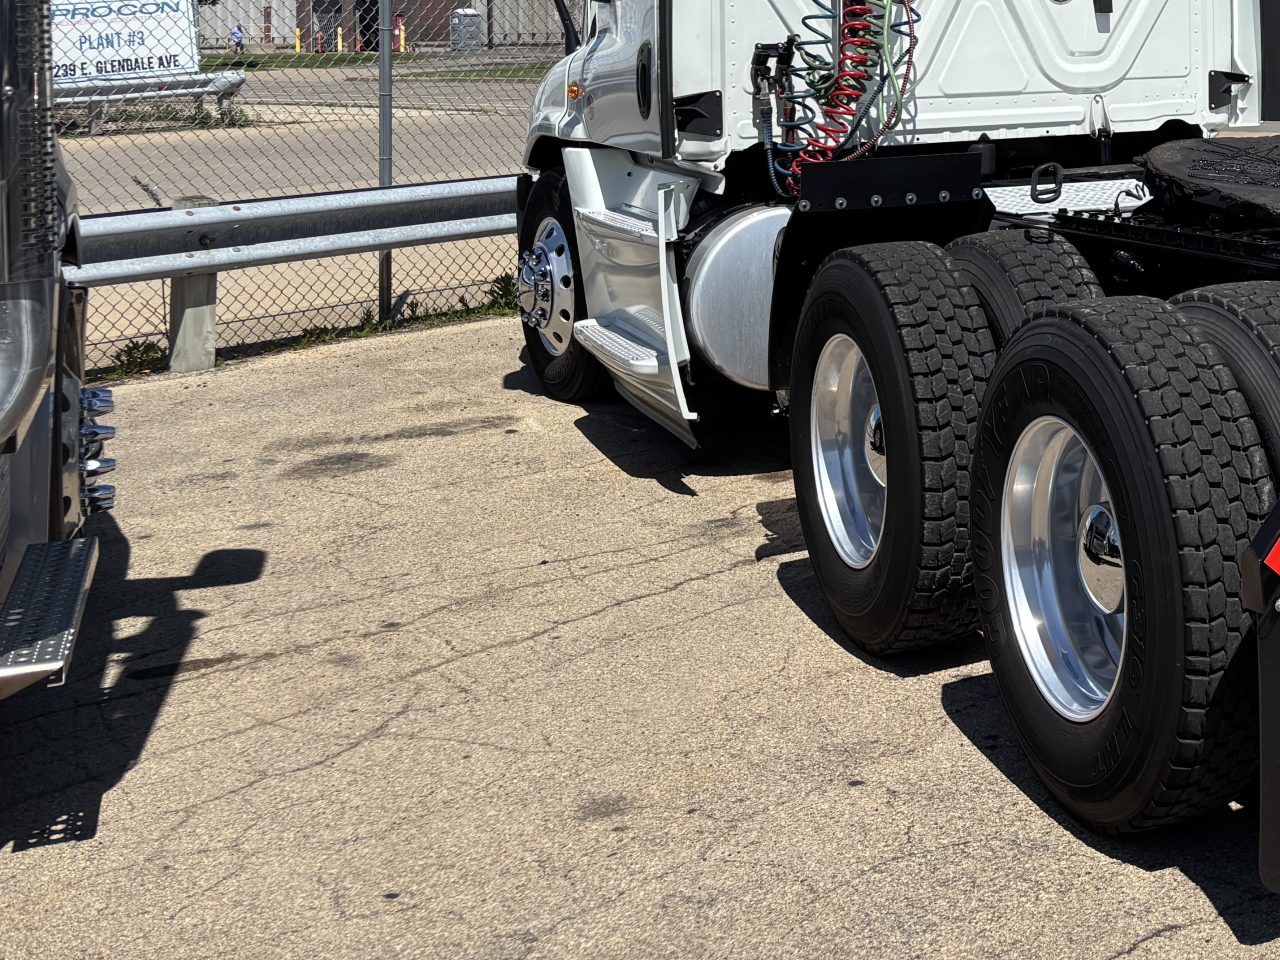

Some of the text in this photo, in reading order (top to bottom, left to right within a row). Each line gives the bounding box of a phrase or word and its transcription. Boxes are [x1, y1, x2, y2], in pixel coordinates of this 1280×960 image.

[79, 31, 145, 51] PLANT #3
[52, 54, 180, 78] 239 E. GLENDALE AVE
